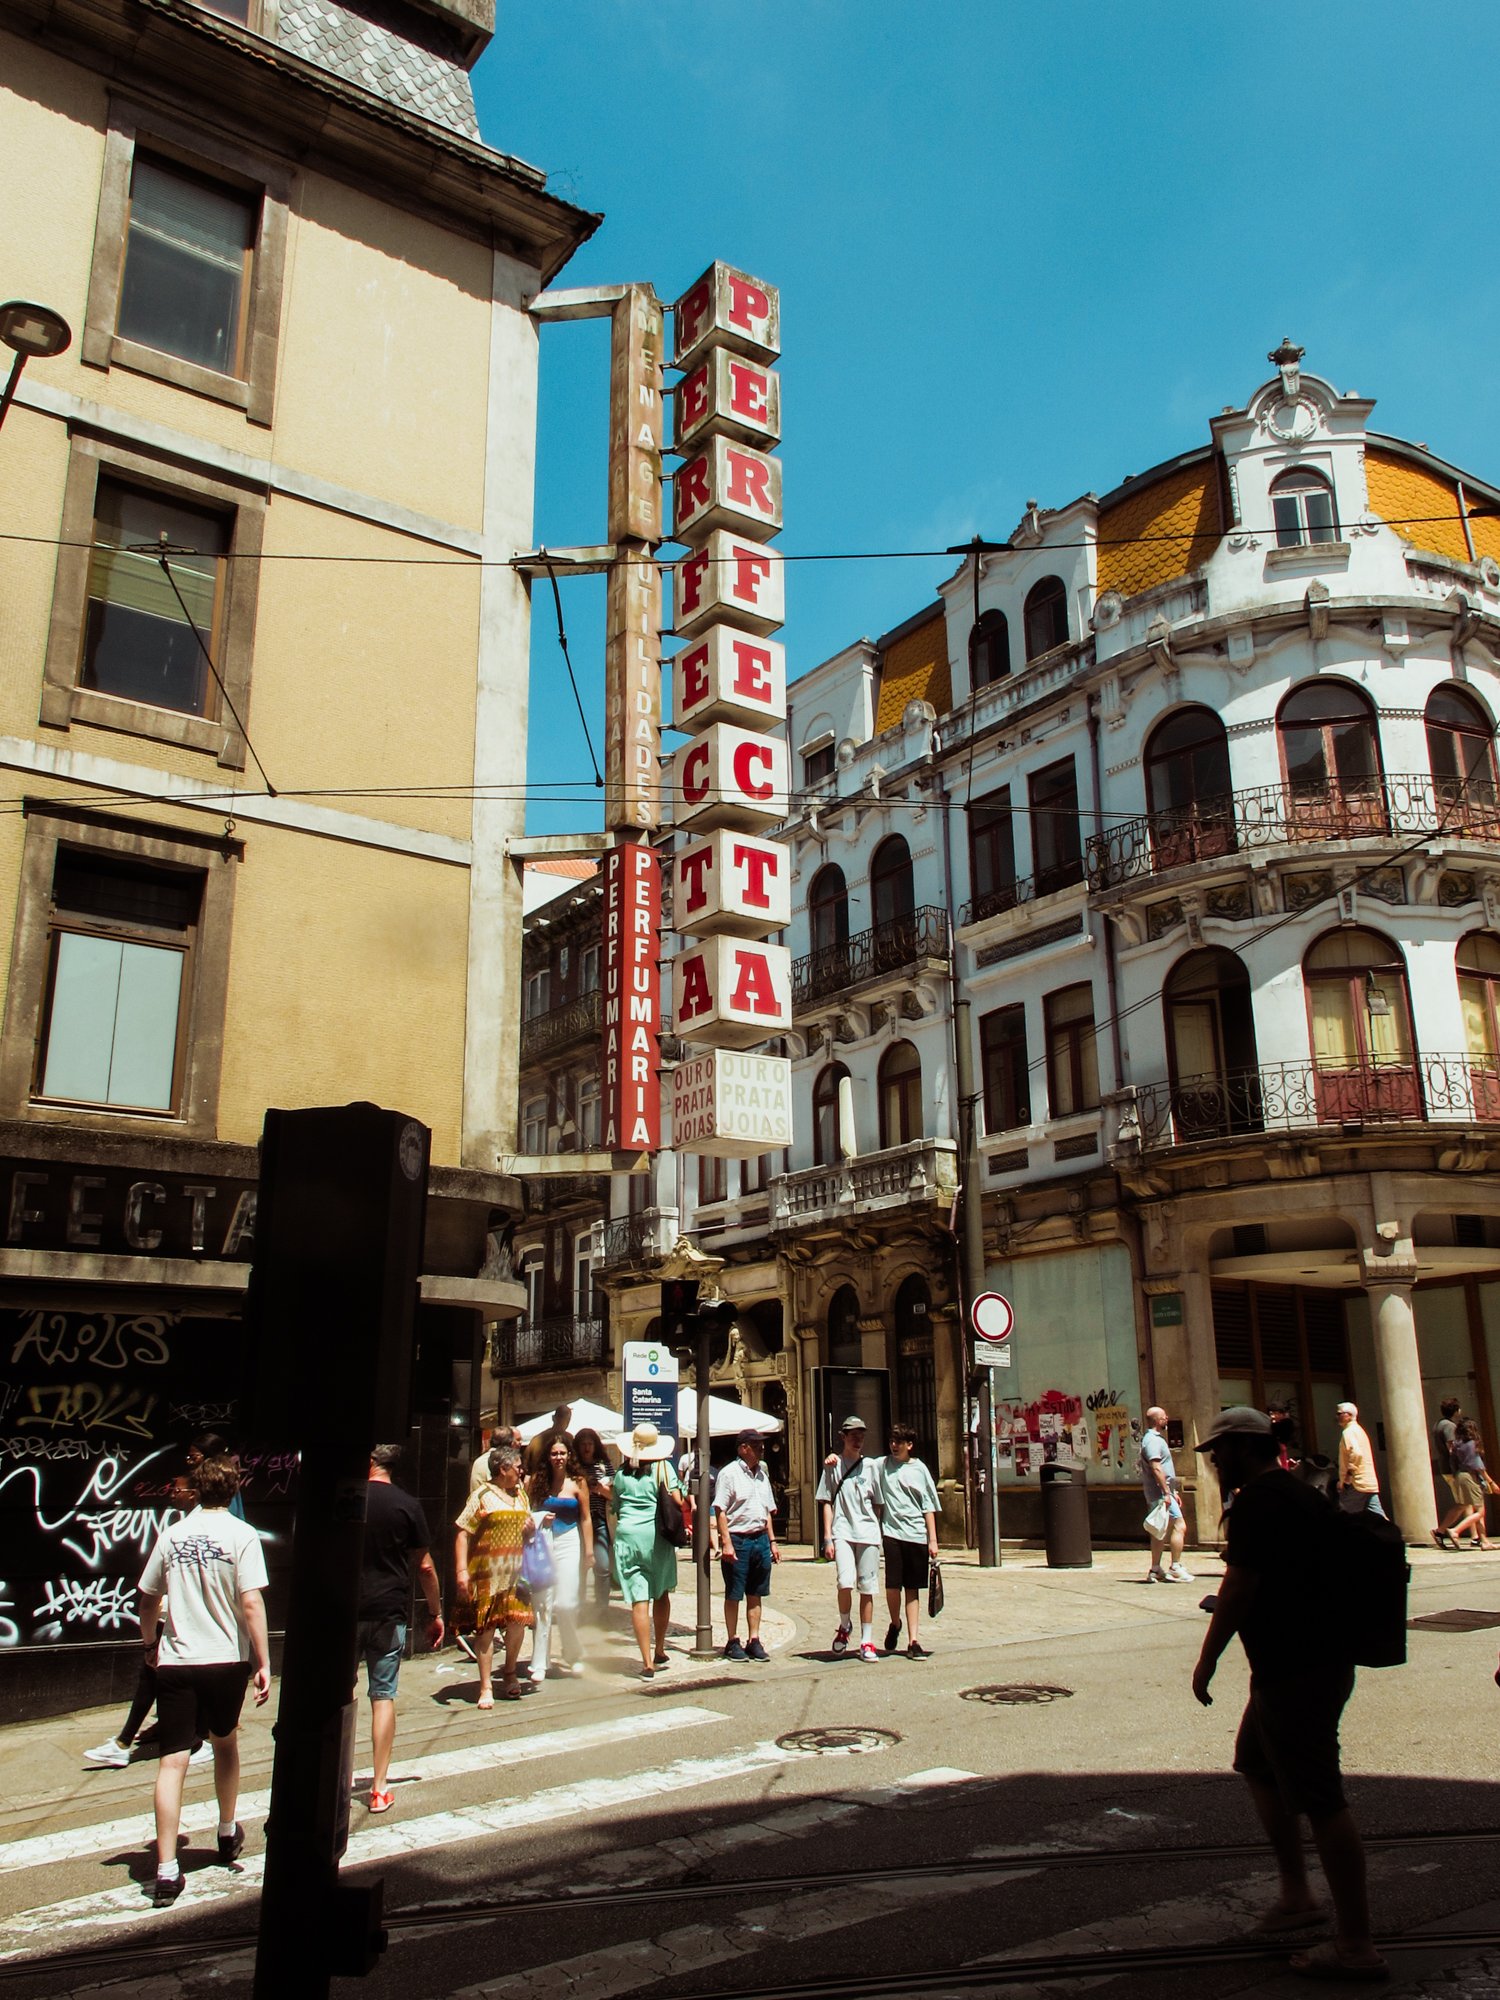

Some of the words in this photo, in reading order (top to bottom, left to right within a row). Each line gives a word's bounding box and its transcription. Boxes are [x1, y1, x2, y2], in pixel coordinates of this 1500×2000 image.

[678, 283, 713, 1023] PERFECTA
[727, 276, 782, 1017] PERFECTA
[636, 560, 653, 824] UTILIDADES
[605, 854, 619, 1146] PERFUMARIA
[630, 850, 652, 1145] PERFUMARIA
[675, 1057, 713, 1091] OURO
[721, 1056, 785, 1084] OURO
[675, 1084, 713, 1118] PRATA
[721, 1082, 785, 1111] PRATA
[675, 1112, 713, 1144] JOIAS
[722, 1110, 786, 1137] JOIAS
[632, 1387, 652, 1395] Santa
